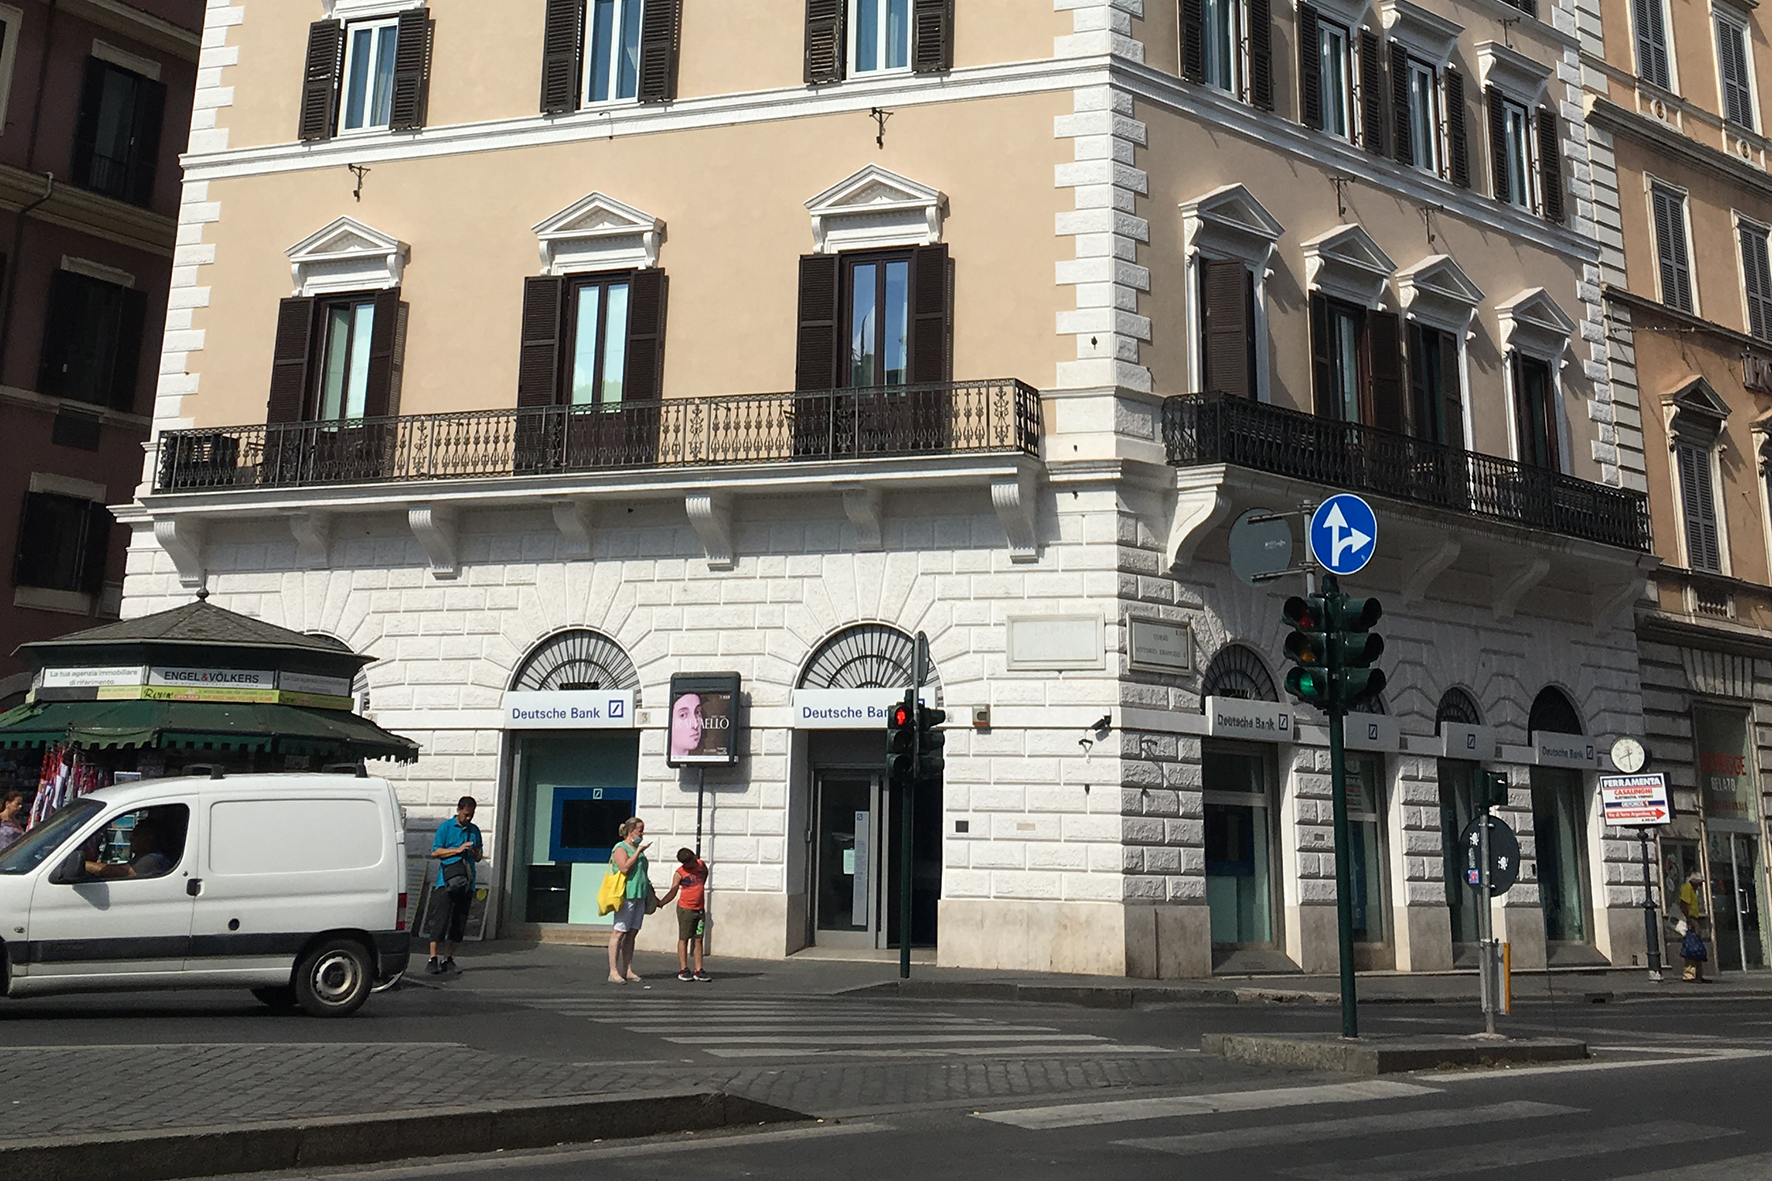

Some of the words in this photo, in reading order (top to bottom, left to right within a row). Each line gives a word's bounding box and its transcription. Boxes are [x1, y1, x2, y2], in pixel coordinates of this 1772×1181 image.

[71, 670, 98, 678] agenzia
[78, 678, 115, 686] riferimento
[512, 708, 567, 719] Deutsche
[571, 707, 600, 719] Bank
[802, 706, 863, 718] Deutsche
[867, 706, 888, 718] Ban
[642, 713, 648, 723] 3
[1217, 714, 1253, 728] Deutsche
[1255, 716, 1275, 731] Bank
[1603, 777, 1661, 787] FERRAMENTA
[1711, 776, 1736, 792] GELATO
